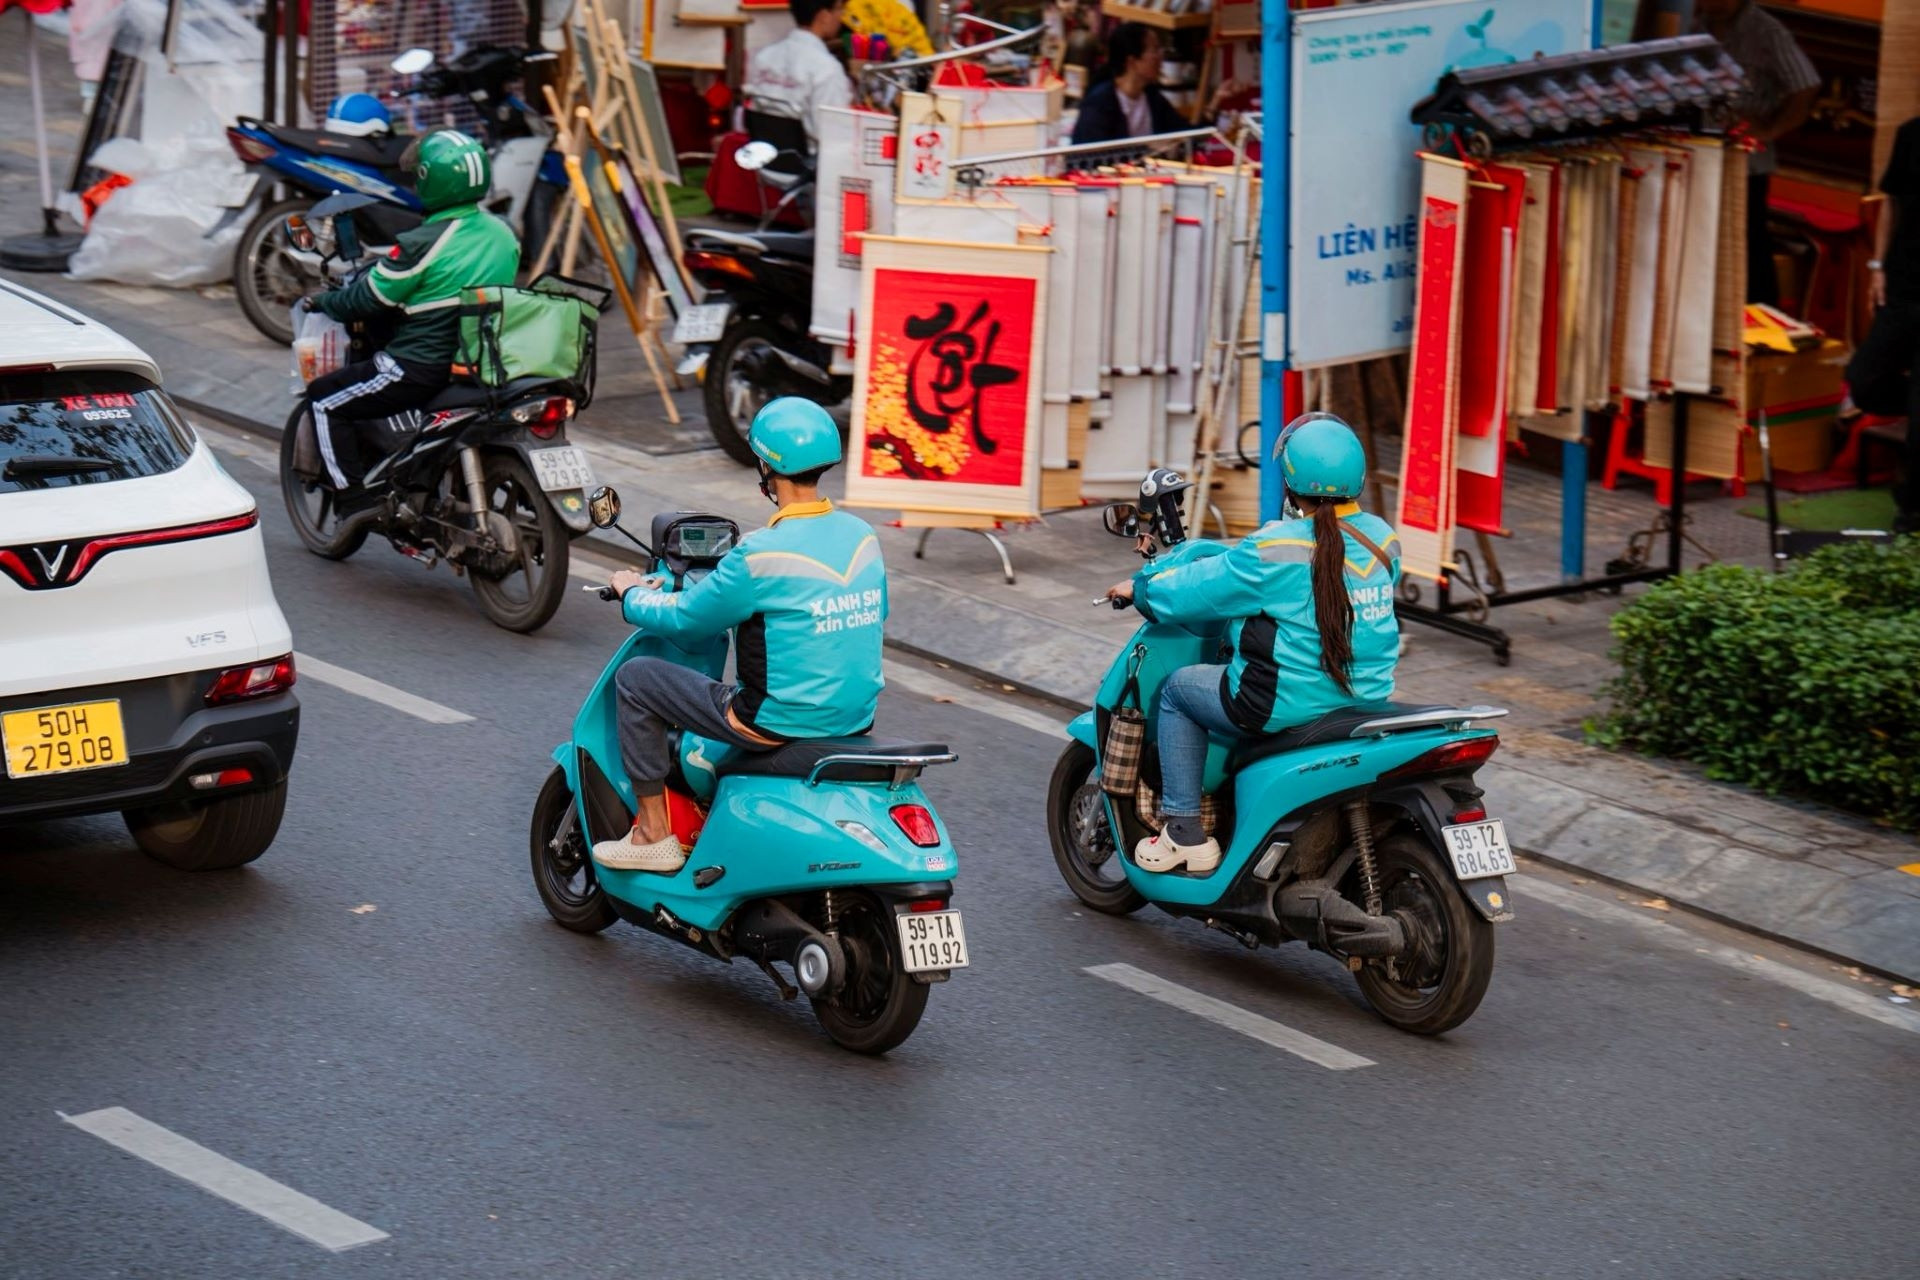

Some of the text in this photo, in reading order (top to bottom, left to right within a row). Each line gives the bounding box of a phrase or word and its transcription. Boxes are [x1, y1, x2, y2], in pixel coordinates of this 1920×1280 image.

[1318, 213, 1418, 260] LIÊN HỆ
[1345, 267, 1378, 287] Ms.
[61, 392, 138, 412] XE TAXI
[82, 408, 132, 421] 093625
[809, 588, 882, 617] XANH SM
[1348, 586, 1379, 606] NH
[815, 615, 843, 634] xin
[38, 708, 89, 739] 50H
[22, 736, 114, 772] 279.08
[1452, 824, 1499, 851] 59-T2
[1457, 847, 1509, 875] 684.65
[907, 915, 955, 941] 59-TA
[909, 940, 964, 968] 119.92
